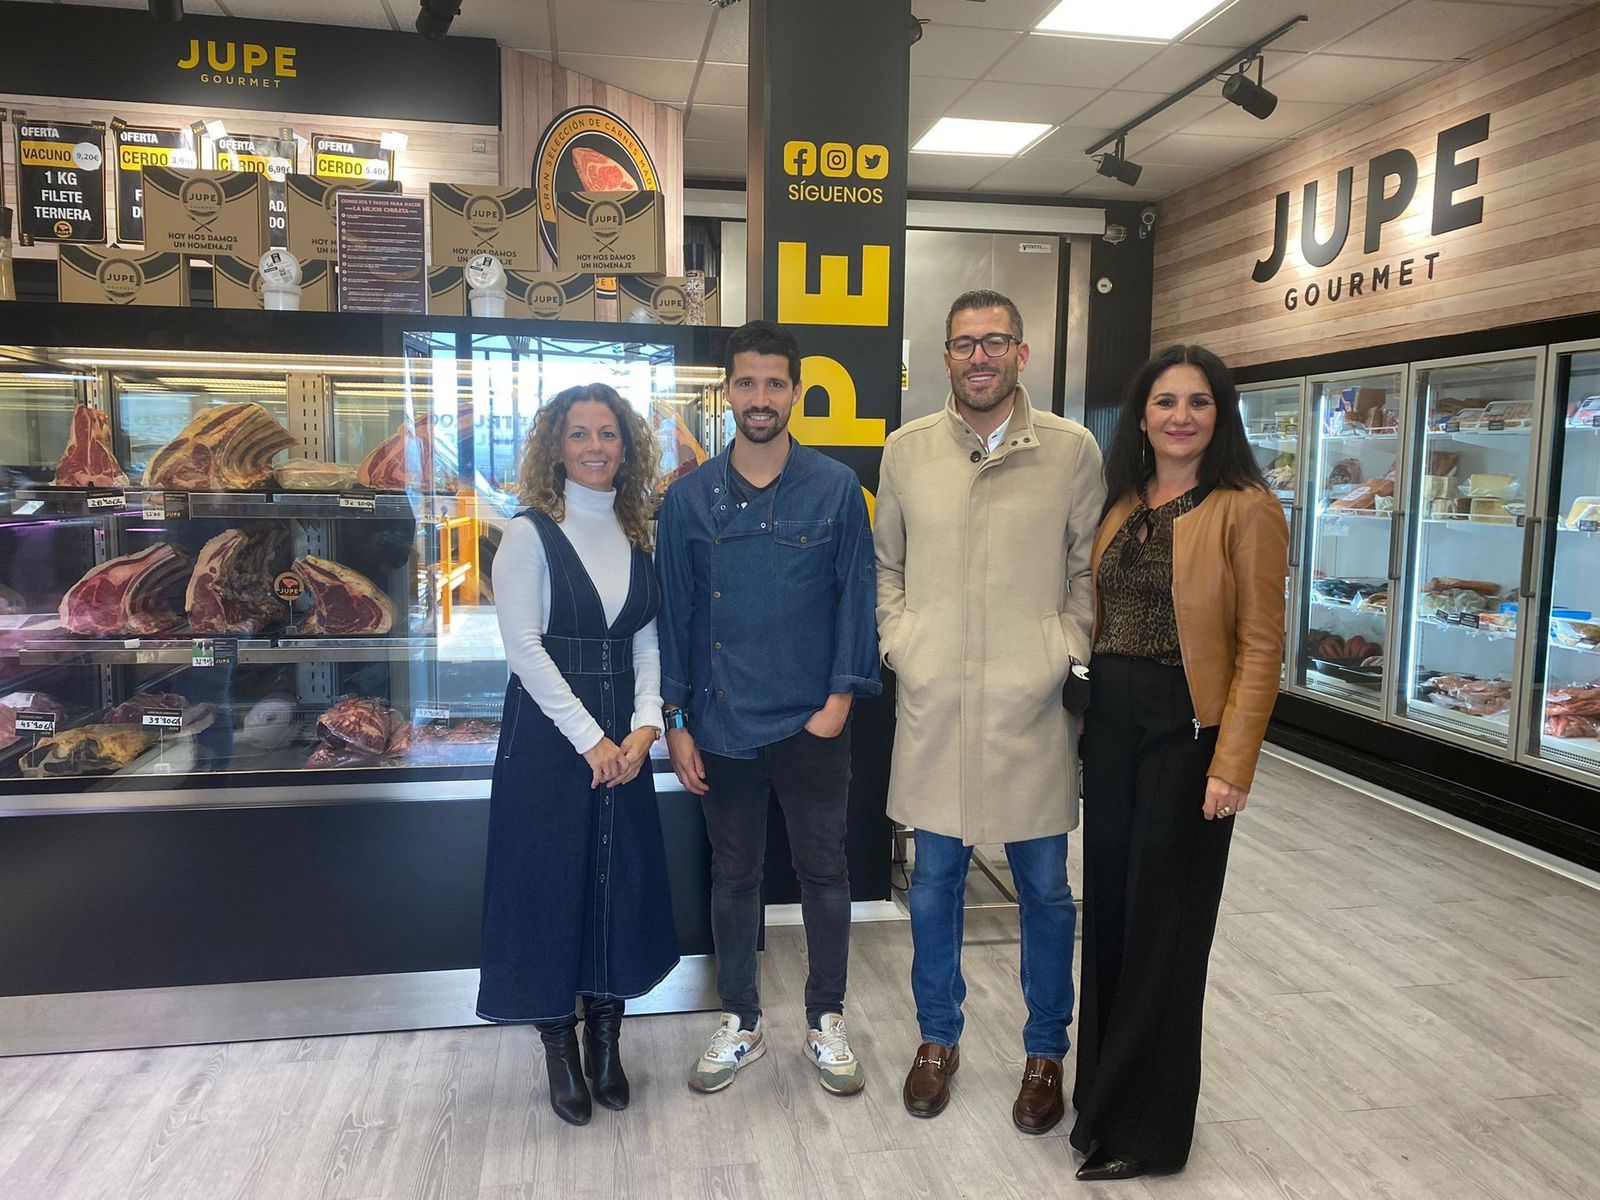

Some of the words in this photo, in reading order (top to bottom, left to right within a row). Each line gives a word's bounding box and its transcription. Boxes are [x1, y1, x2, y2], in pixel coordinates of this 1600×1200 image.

[176, 39, 297, 77] JUPE
[200, 73, 281, 88] GOURMET
[20, 126, 60, 138] OFERTA
[120, 131, 159, 144] OFERTA
[218, 139, 256, 152] OFERTA
[318, 140, 354, 153] OFERTA
[22, 147, 71, 161] VACUNO
[76, 152, 99, 161] 9,20€
[122, 150, 168, 166] CERDO
[318, 158, 363, 175] CERDO
[543, 172, 551, 211] GRAN
[588, 118, 600, 126] DE
[604, 122, 638, 156] CARNES
[44, 170, 52, 184] 1
[57, 172, 77, 185] KG
[41, 189, 83, 203] FILETE
[188, 193, 216, 202] JUPE
[787, 179, 884, 205] SÍGUENOS
[1251, 112, 1491, 283] JUPE
[33, 206, 92, 221] TERNERA
[472, 210, 498, 219] JUPE
[594, 215, 618, 224] JUPE
[168, 232, 186, 240] HOY
[187, 233, 205, 241] NOS
[207, 234, 238, 243] DAMOS
[311, 238, 329, 246] HOY
[187, 242, 234, 251] HOMENAJE
[316, 246, 328, 254] UN
[452, 247, 469, 255] HOY
[457, 255, 468, 263] UN
[576, 253, 591, 261] HOY
[592, 254, 609, 262] NOS
[609, 254, 636, 262] DAMOS
[580, 261, 592, 269] UN
[592, 261, 632, 270] HOMENAJE
[106, 274, 136, 283] JUPE
[1284, 252, 1440, 312] GOURMET
[533, 295, 558, 304] JUPE
[658, 299, 682, 308] JUPE
